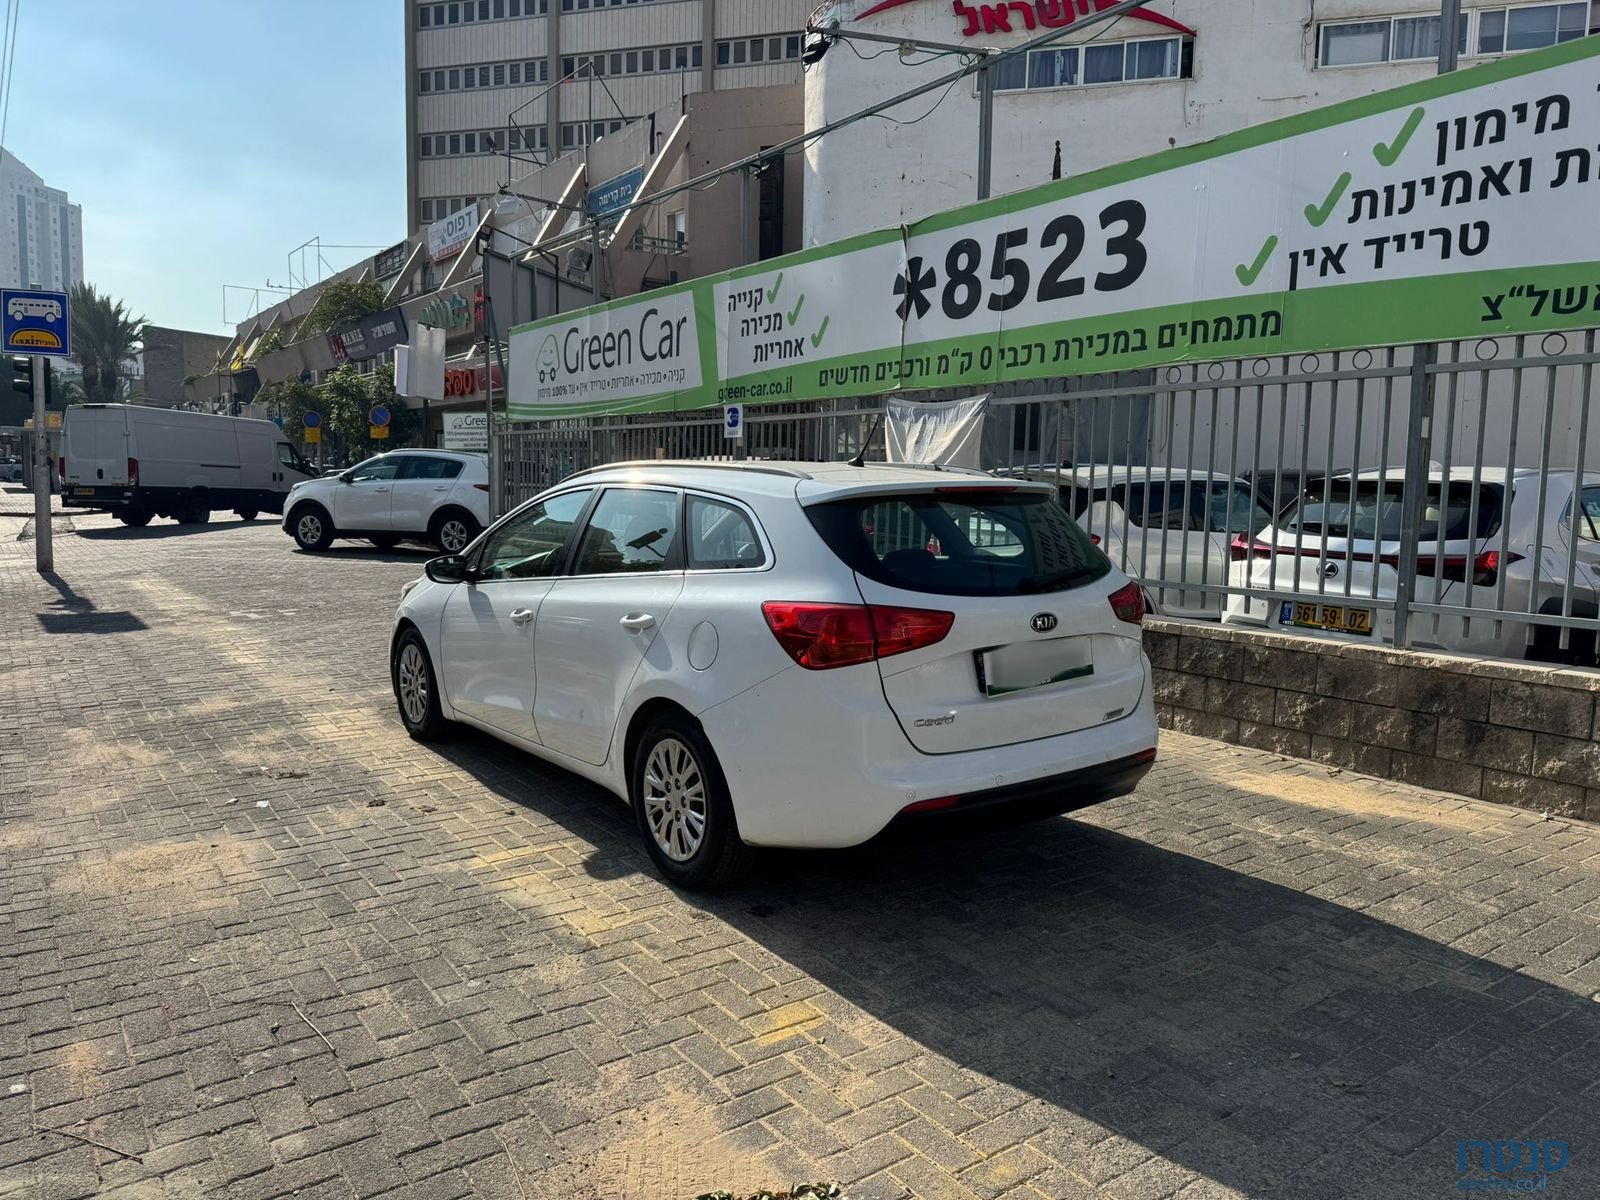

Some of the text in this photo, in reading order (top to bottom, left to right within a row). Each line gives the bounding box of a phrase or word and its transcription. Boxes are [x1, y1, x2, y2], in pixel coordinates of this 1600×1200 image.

[1436, 94, 1570, 166] מימון
[620, 184, 632, 198] בית
[1347, 157, 1533, 224] ואמינות
[446, 210, 473, 237] דפוס
[1288, 220, 1490, 291] טרייד אין
[728, 287, 763, 312] קנייה
[741, 312, 783, 337] מכירה
[1157, 310, 1282, 349] מתמחים
[564, 308, 687, 374] Green Car
[753, 337, 805, 363] אחריות
[1052, 328, 1147, 362] במכירת
[980, 345, 992, 370] 0
[1000, 342, 1045, 368] רכבי
[640, 371, 662, 385] מכירה
[668, 368, 685, 385] קניה
[819, 364, 870, 387] חדשים
[875, 357, 930, 381] ורכבים
[552, 385, 568, 396] 100%
[611, 376, 635, 389] אחריות
[718, 375, 793, 403] green-car.co.il
